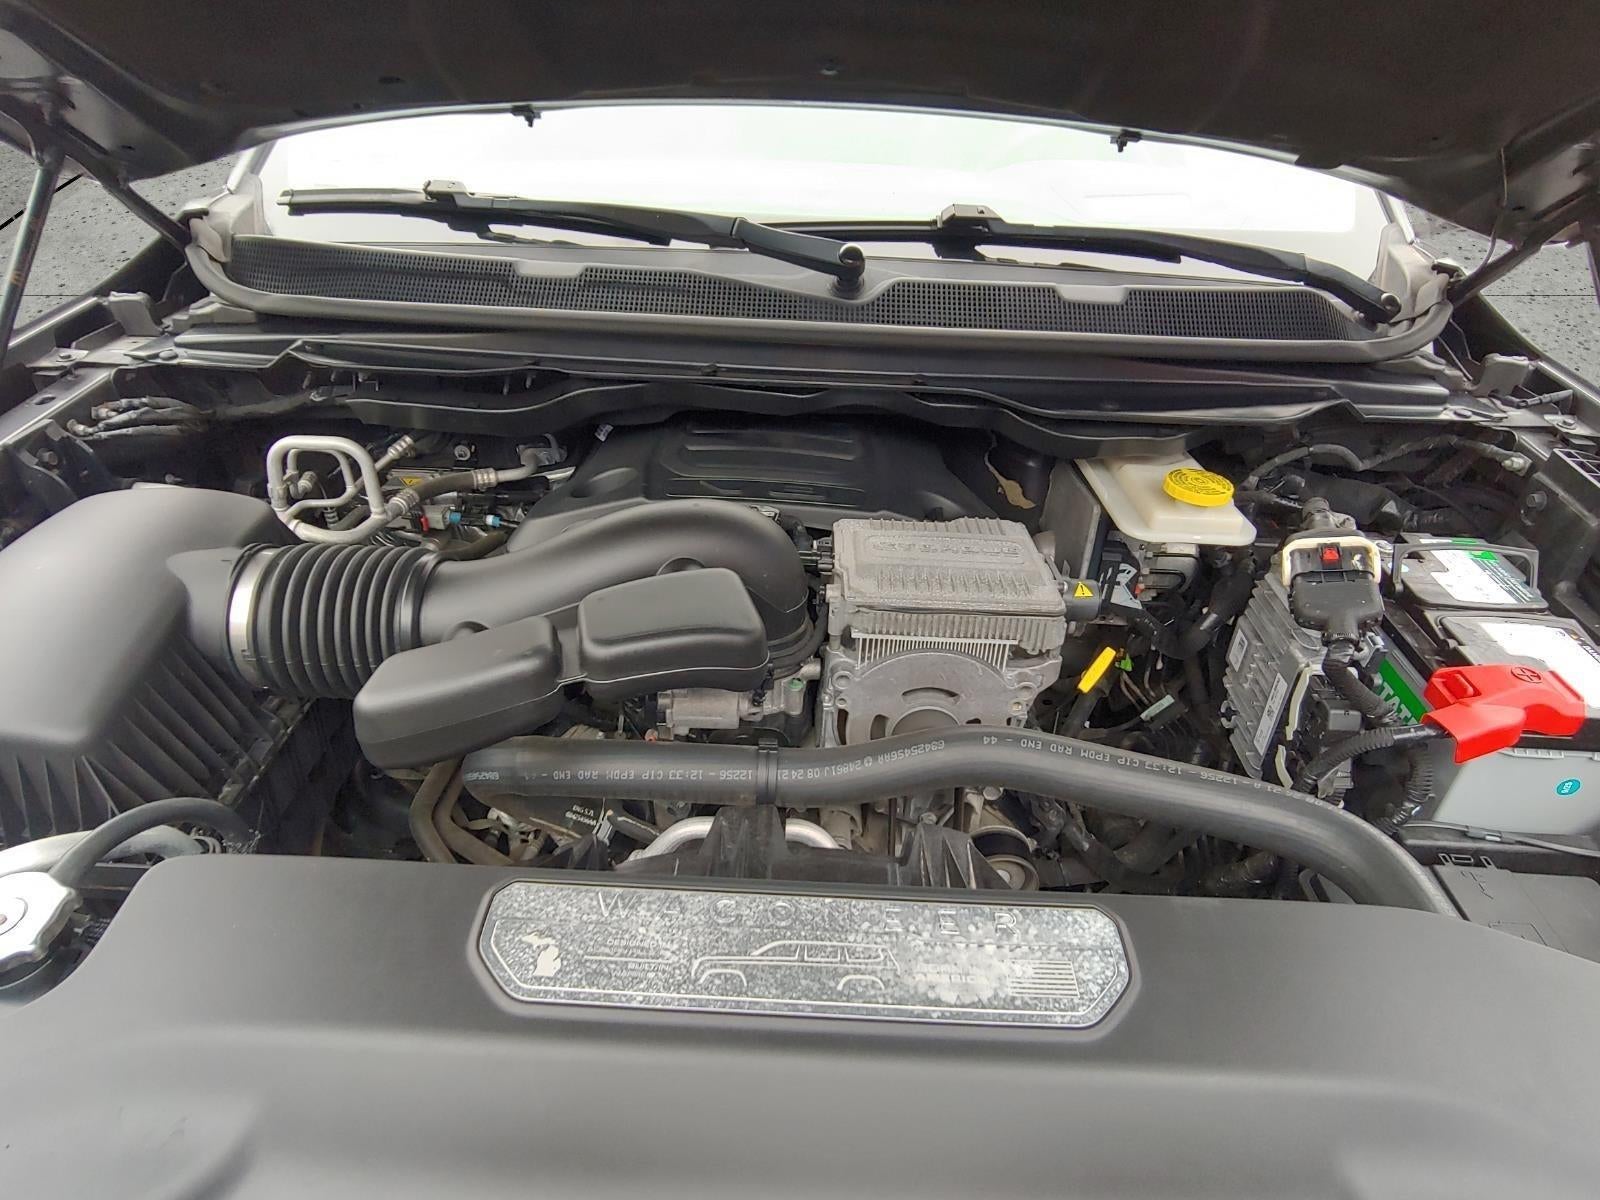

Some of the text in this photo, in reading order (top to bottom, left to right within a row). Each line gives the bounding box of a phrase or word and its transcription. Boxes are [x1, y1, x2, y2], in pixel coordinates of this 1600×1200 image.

[982, 735, 998, 745] 44
[1020, 737, 1042, 750] END
[1049, 743, 1073, 755] RAD
[1080, 748, 1110, 762] EPDM
[577, 769, 599, 780] RAD
[668, 769, 704, 780] 12:33
[719, 769, 753, 780] 12256
[791, 769, 804, 780] 24
[1200, 771, 1237, 785] 12256
